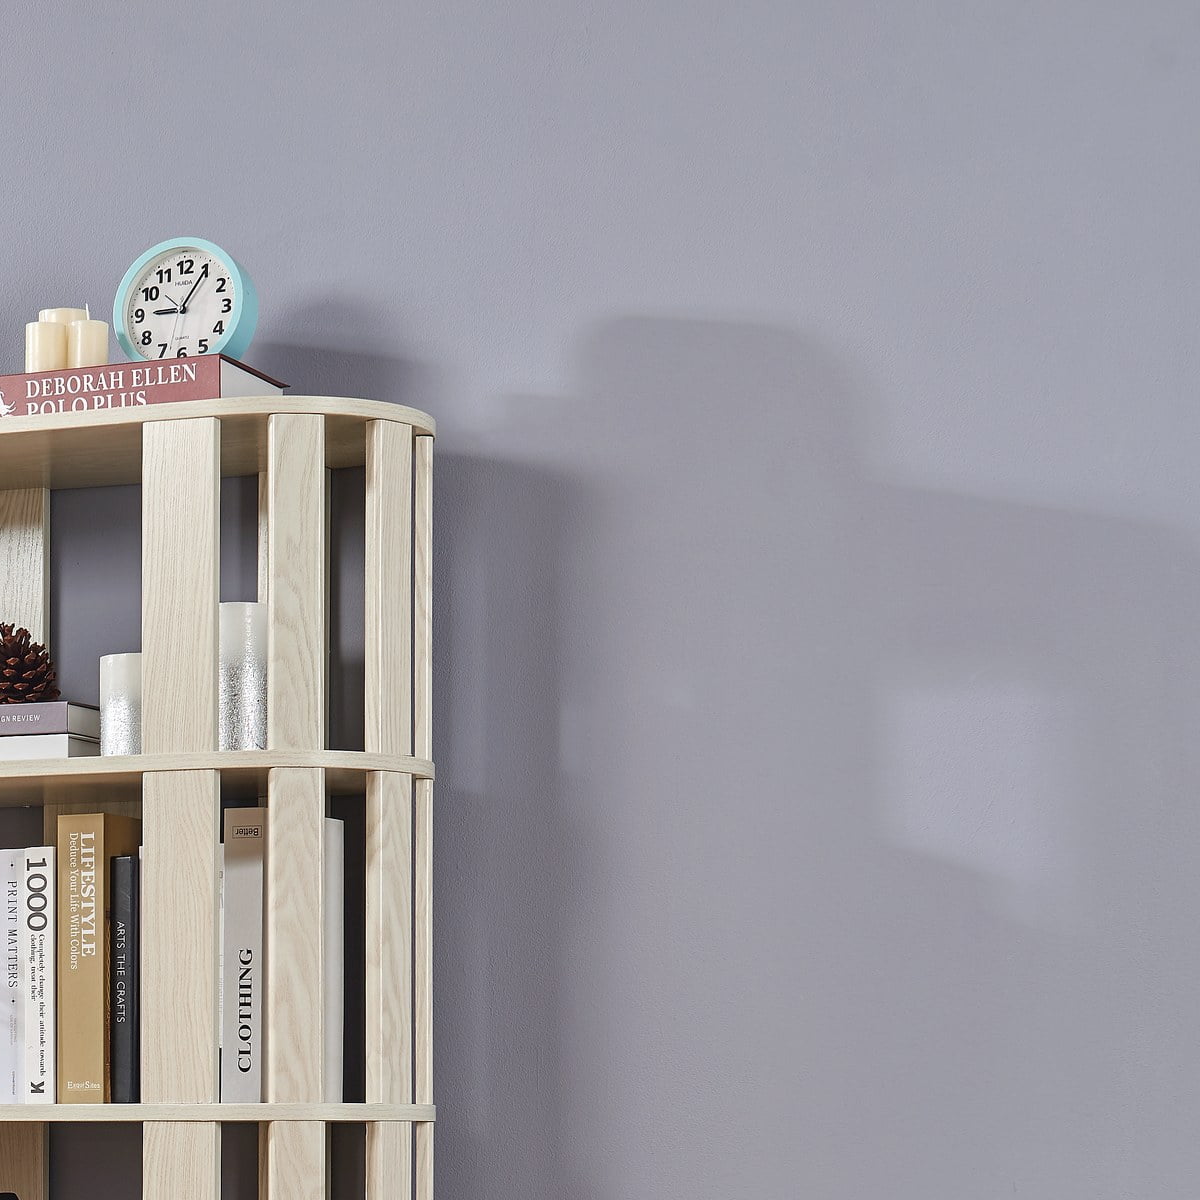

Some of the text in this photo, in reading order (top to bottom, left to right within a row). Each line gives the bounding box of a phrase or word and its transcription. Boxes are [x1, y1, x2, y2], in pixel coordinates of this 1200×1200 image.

[177, 259, 194, 275] 12
[201, 263, 209, 278] 1
[156, 268, 172, 283] 11
[216, 278, 226, 293] 2
[141, 286, 159, 302] 10
[221, 298, 232, 313] 3
[134, 308, 145, 324] 9
[213, 320, 224, 335] 4
[141, 330, 152, 346] 8
[157, 343, 168, 358] 7
[176, 347, 188, 359] 6
[198, 339, 209, 354] 5
[26, 362, 197, 399] DEBORAH ELLEN
[12, 713, 41, 723] REVIEW
[26, 857, 48, 931] 1000
[69, 832, 79, 970] Deduce Your Life With Colors
[80, 831, 96, 957] LIFESTYLE
[7, 881, 18, 988] PRINT MATTERS
[116, 921, 126, 1023] ARTS THE CRAFTS
[38, 975, 46, 1000] change
[238, 948, 253, 1073] CLOTHING
[39, 1020, 47, 1047] attitude
